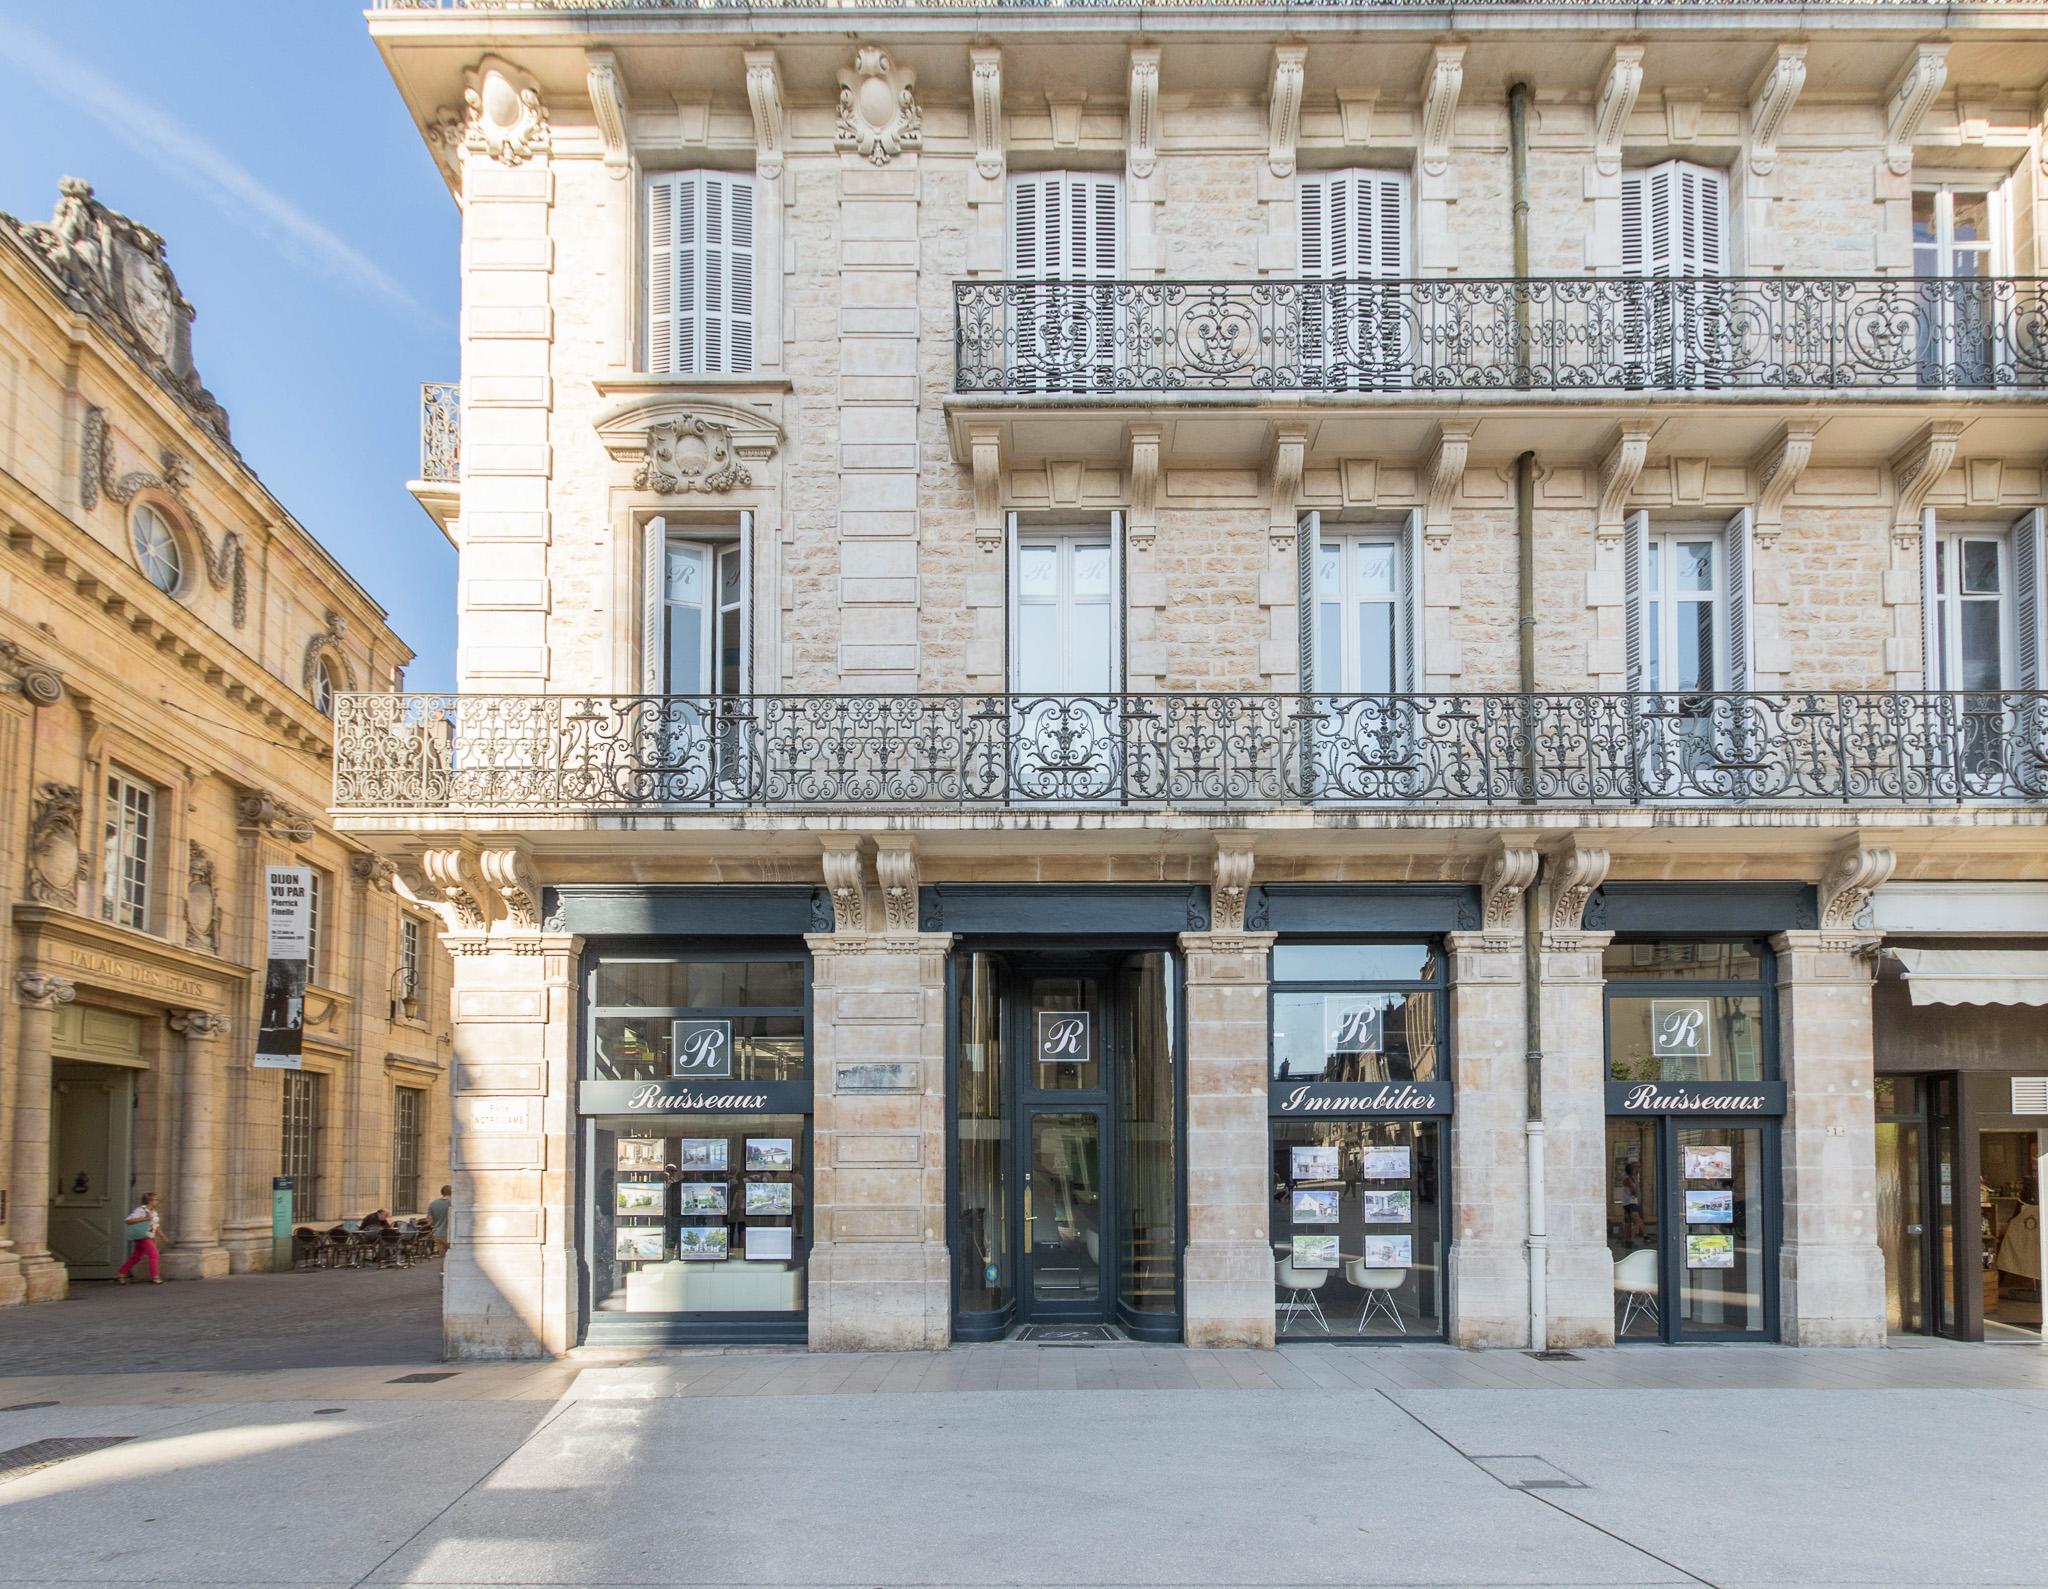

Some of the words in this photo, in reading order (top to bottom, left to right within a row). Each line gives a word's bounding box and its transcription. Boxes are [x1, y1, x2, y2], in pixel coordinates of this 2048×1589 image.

[270, 873, 299, 885] DIJON
[270, 886, 285, 897] VU
[286, 887, 305, 898] PAR
[71, 950, 123, 976] PALAIS
[131, 965, 160, 985] DES
[1044, 1018, 1084, 1054] R
[1331, 1004, 1377, 1044] R
[1658, 1008, 1704, 1048] R
[679, 1028, 725, 1068] R
[628, 1083, 768, 1110] Ruisseaux
[1281, 1085, 1436, 1111] Immobilier
[1624, 1083, 1765, 1110] Ruisseaux
